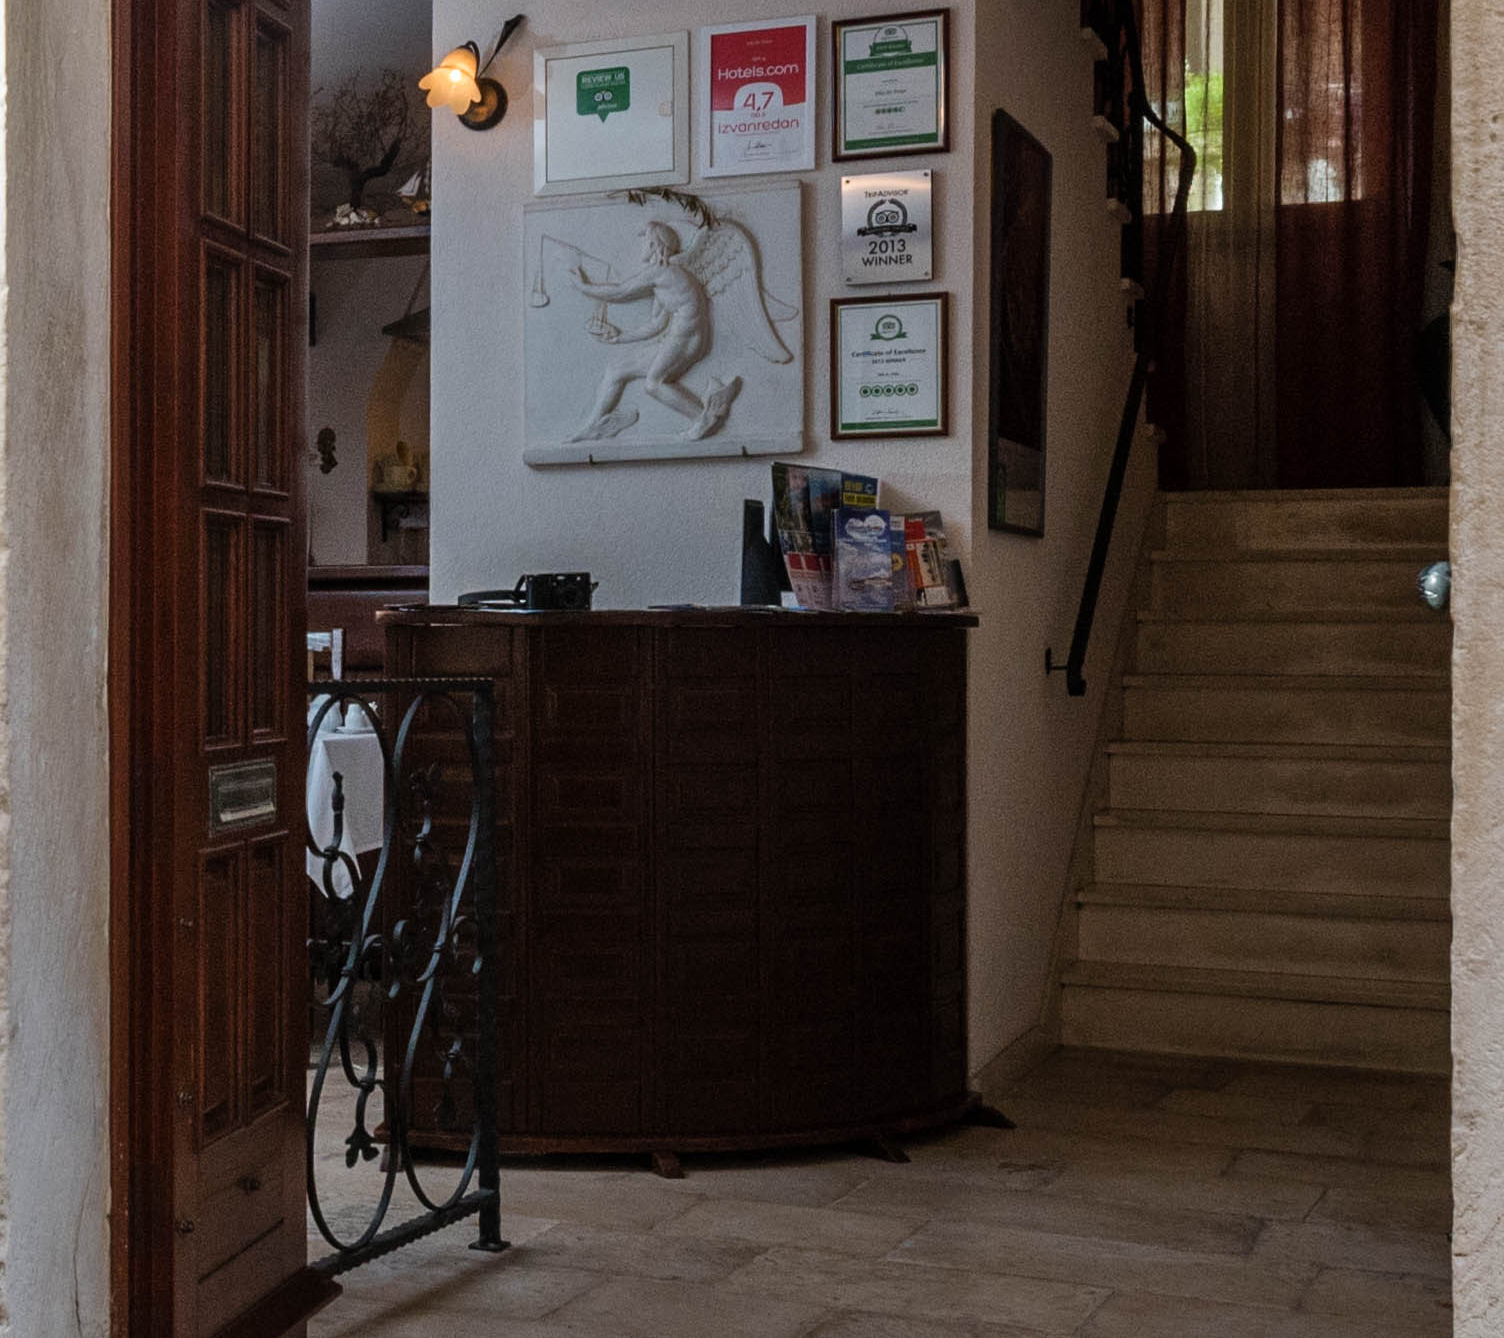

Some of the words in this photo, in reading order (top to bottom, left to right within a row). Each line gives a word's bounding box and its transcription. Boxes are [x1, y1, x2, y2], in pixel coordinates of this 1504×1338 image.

[718, 64, 799, 80] Hotels.com
[743, 91, 775, 112] 4,7
[869, 239, 906, 255] 2013
[862, 254, 913, 267] WINNER
